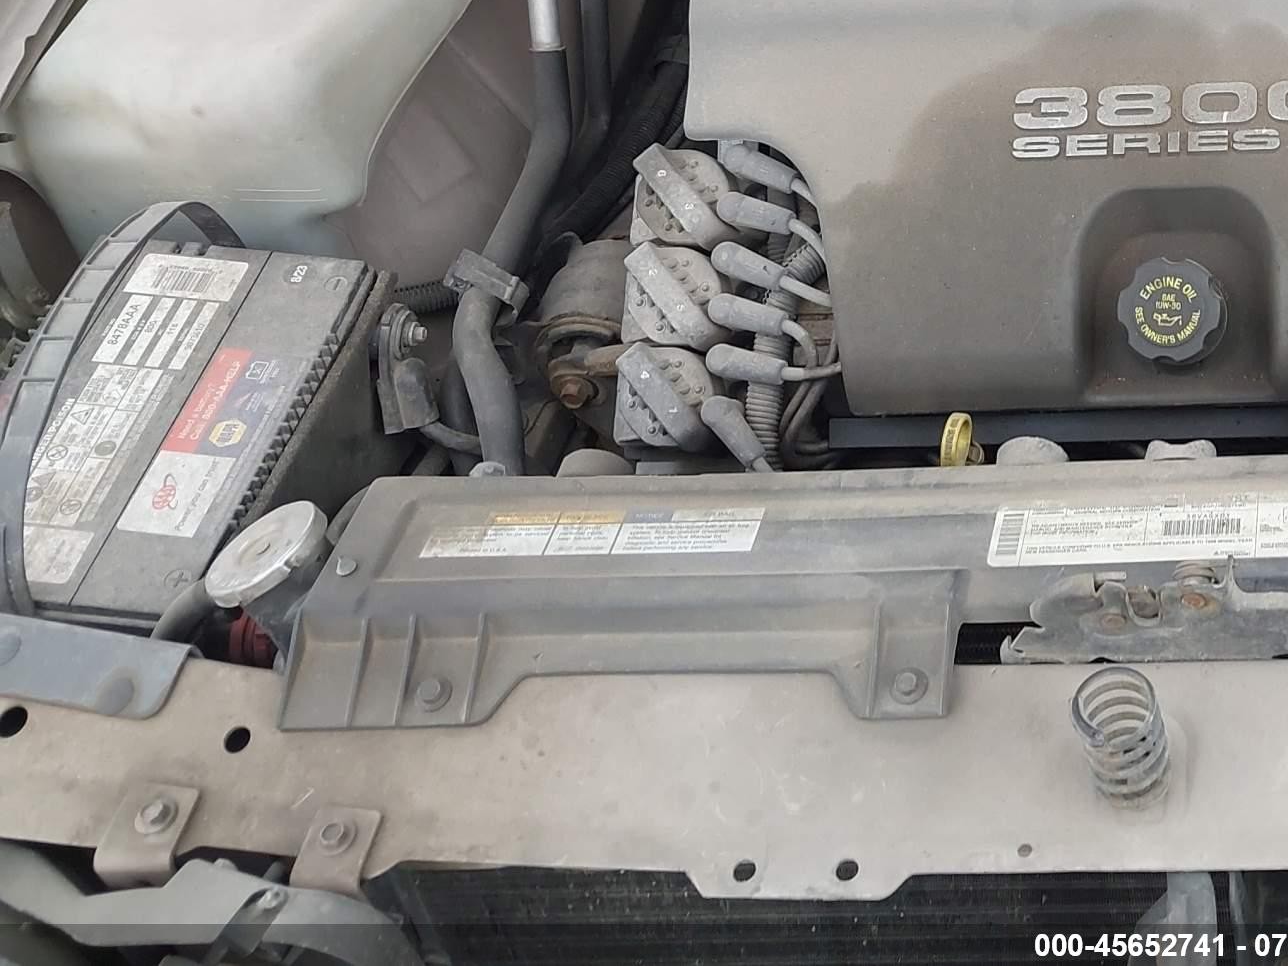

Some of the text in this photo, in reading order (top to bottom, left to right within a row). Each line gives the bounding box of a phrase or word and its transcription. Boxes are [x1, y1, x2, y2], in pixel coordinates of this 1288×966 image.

[1012, 128, 1281, 159] SERIES
[290, 265, 308, 283] 8/23
[1140, 276, 1198, 303] ENGINE OIL
[1162, 294, 1176, 302] SAE
[107, 303, 141, 346] 8478AAA
[1135, 306, 1201, 345] SEE OWNER'S MANUAL
